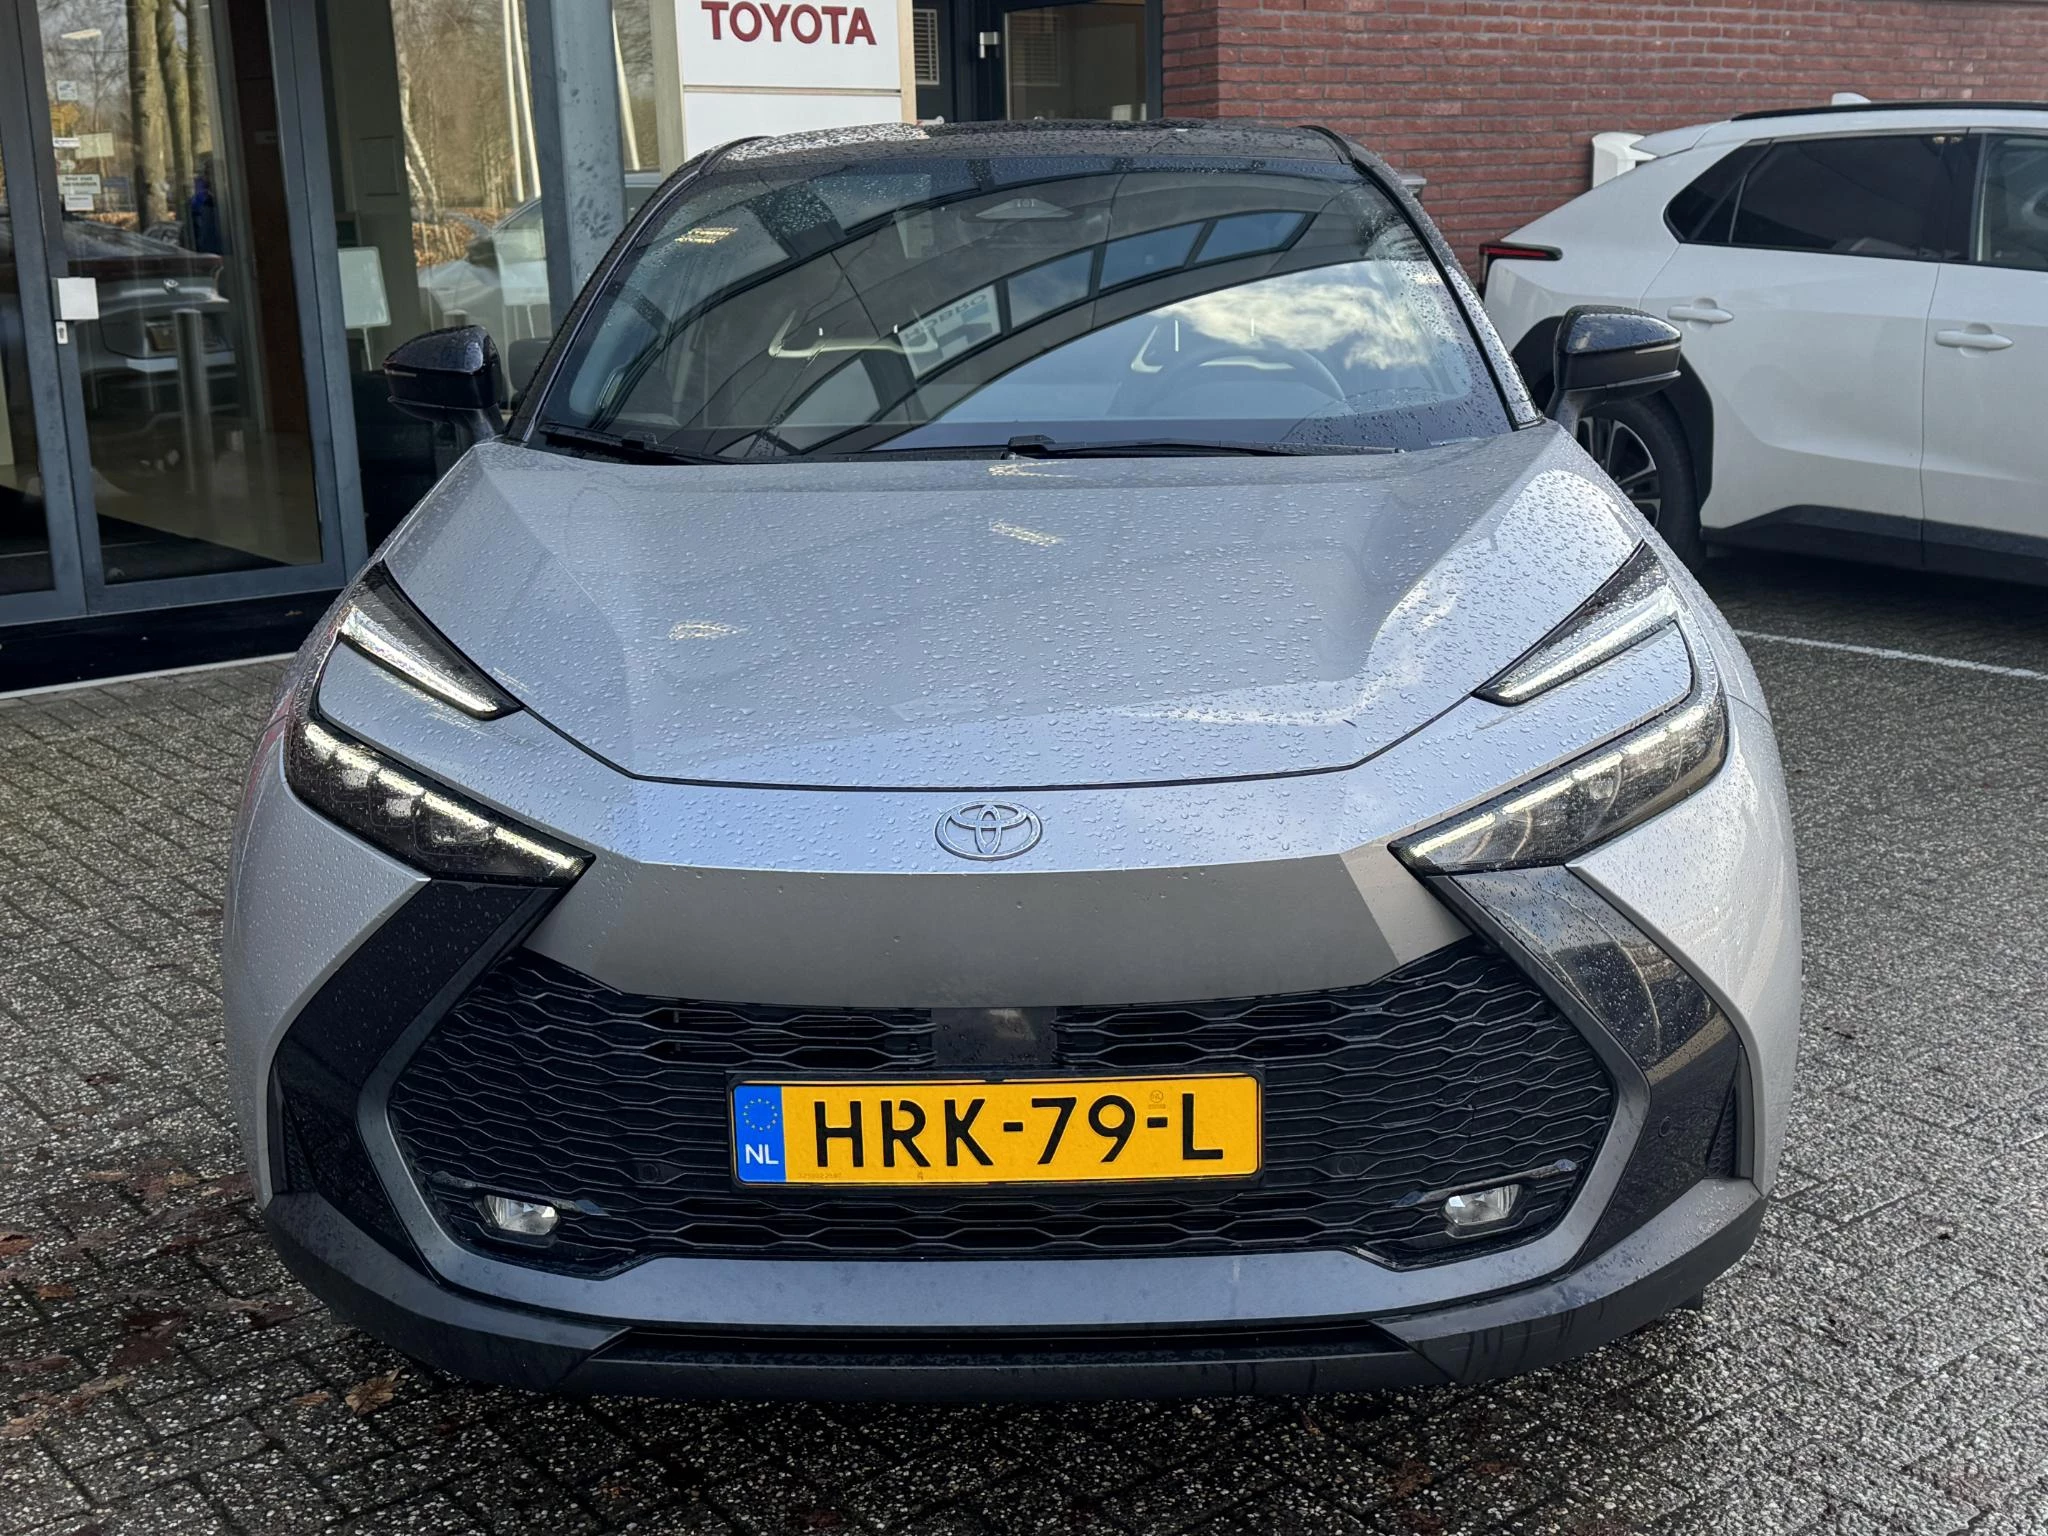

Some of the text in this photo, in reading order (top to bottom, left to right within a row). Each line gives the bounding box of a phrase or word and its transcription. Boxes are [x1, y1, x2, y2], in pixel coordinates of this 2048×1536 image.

[701, 1, 877, 46] TOYOTA
[814, 1093, 1223, 1167] HRK-79-L
[745, 1143, 779, 1165] NL
